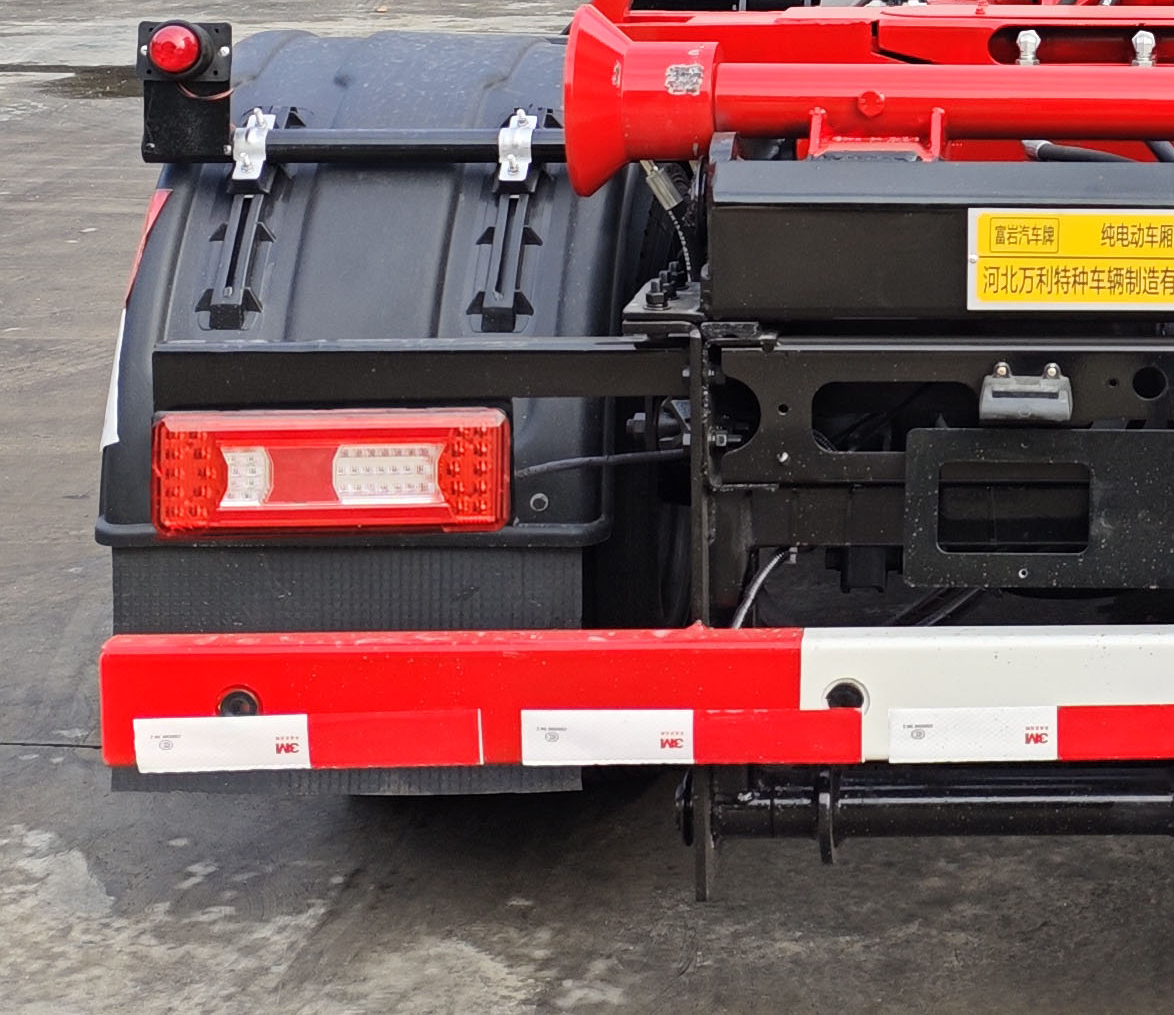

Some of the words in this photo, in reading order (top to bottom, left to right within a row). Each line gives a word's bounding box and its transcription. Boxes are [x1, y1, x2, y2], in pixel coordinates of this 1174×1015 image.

[995, 224, 1054, 246] 富岩汽车牌
[660, 738, 683, 749] 3M
[1025, 733, 1048, 744] 3M
[275, 743, 299, 754] 3M
